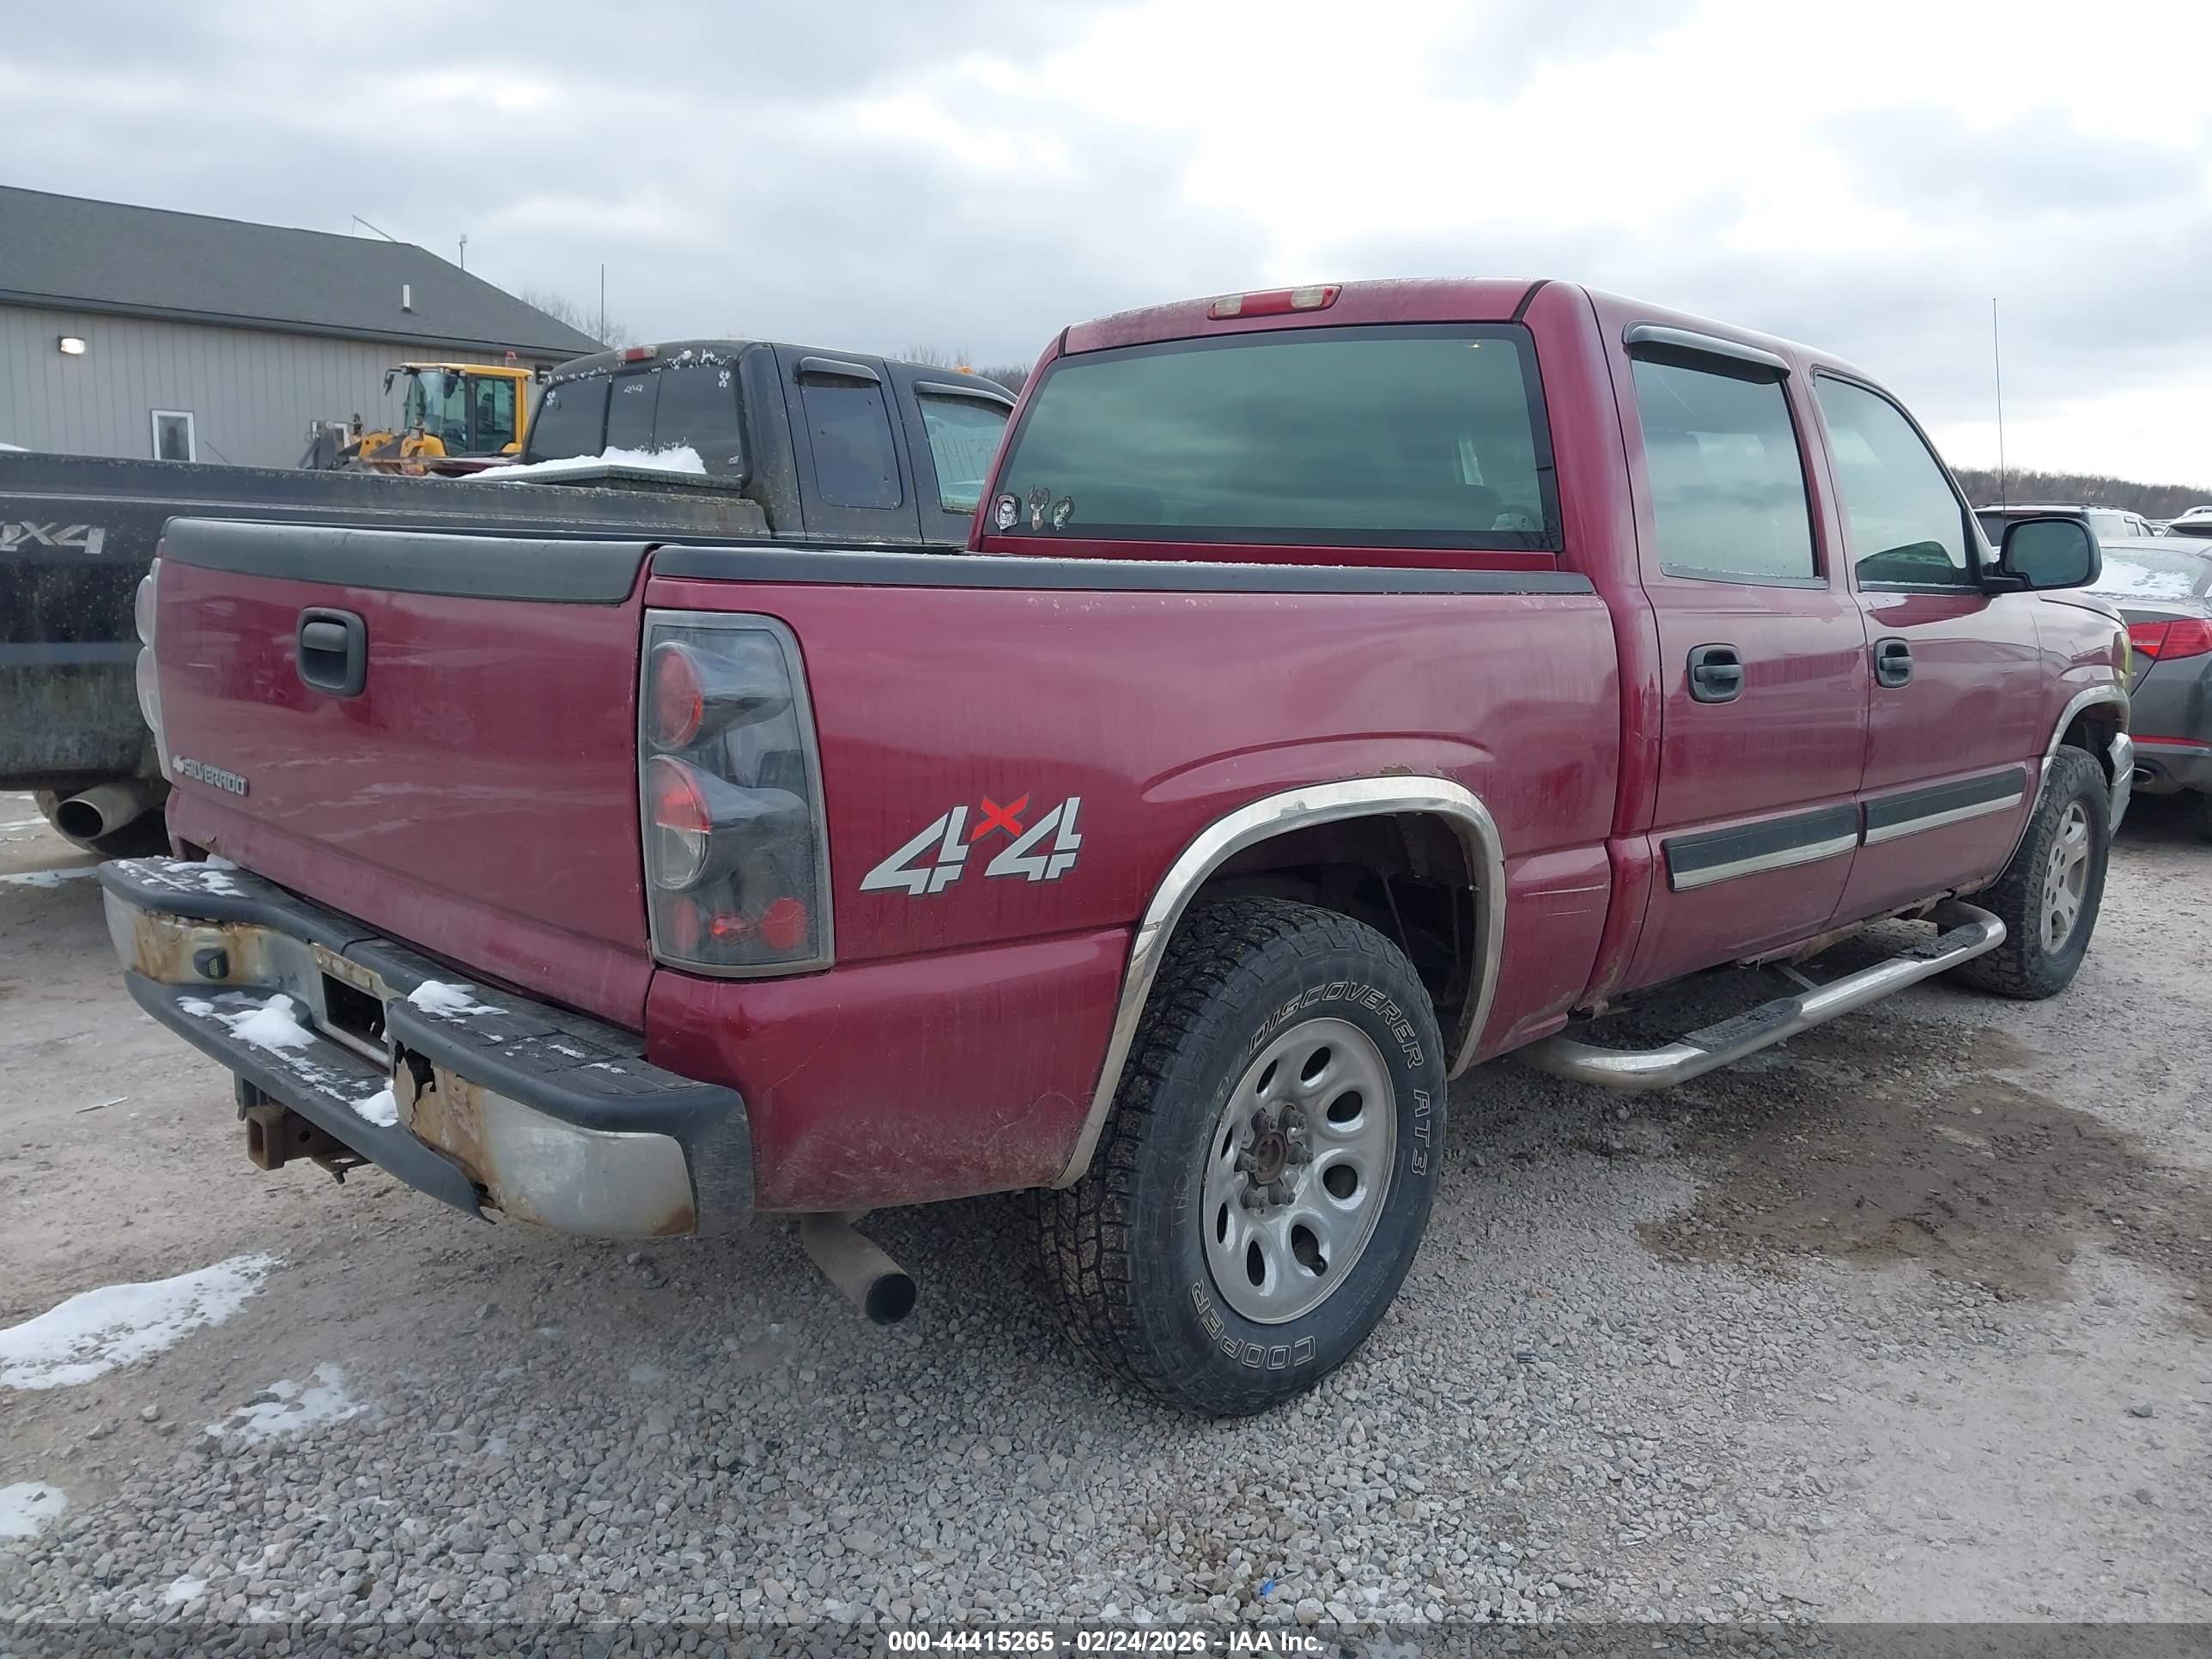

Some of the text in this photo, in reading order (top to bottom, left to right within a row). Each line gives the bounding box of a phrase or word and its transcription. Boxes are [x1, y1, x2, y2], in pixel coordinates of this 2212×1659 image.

[183, 757, 246, 796] SILVERADO
[1249, 981, 1425, 1070] DISCOVERER
[1191, 1278, 1316, 1370] COOPER
